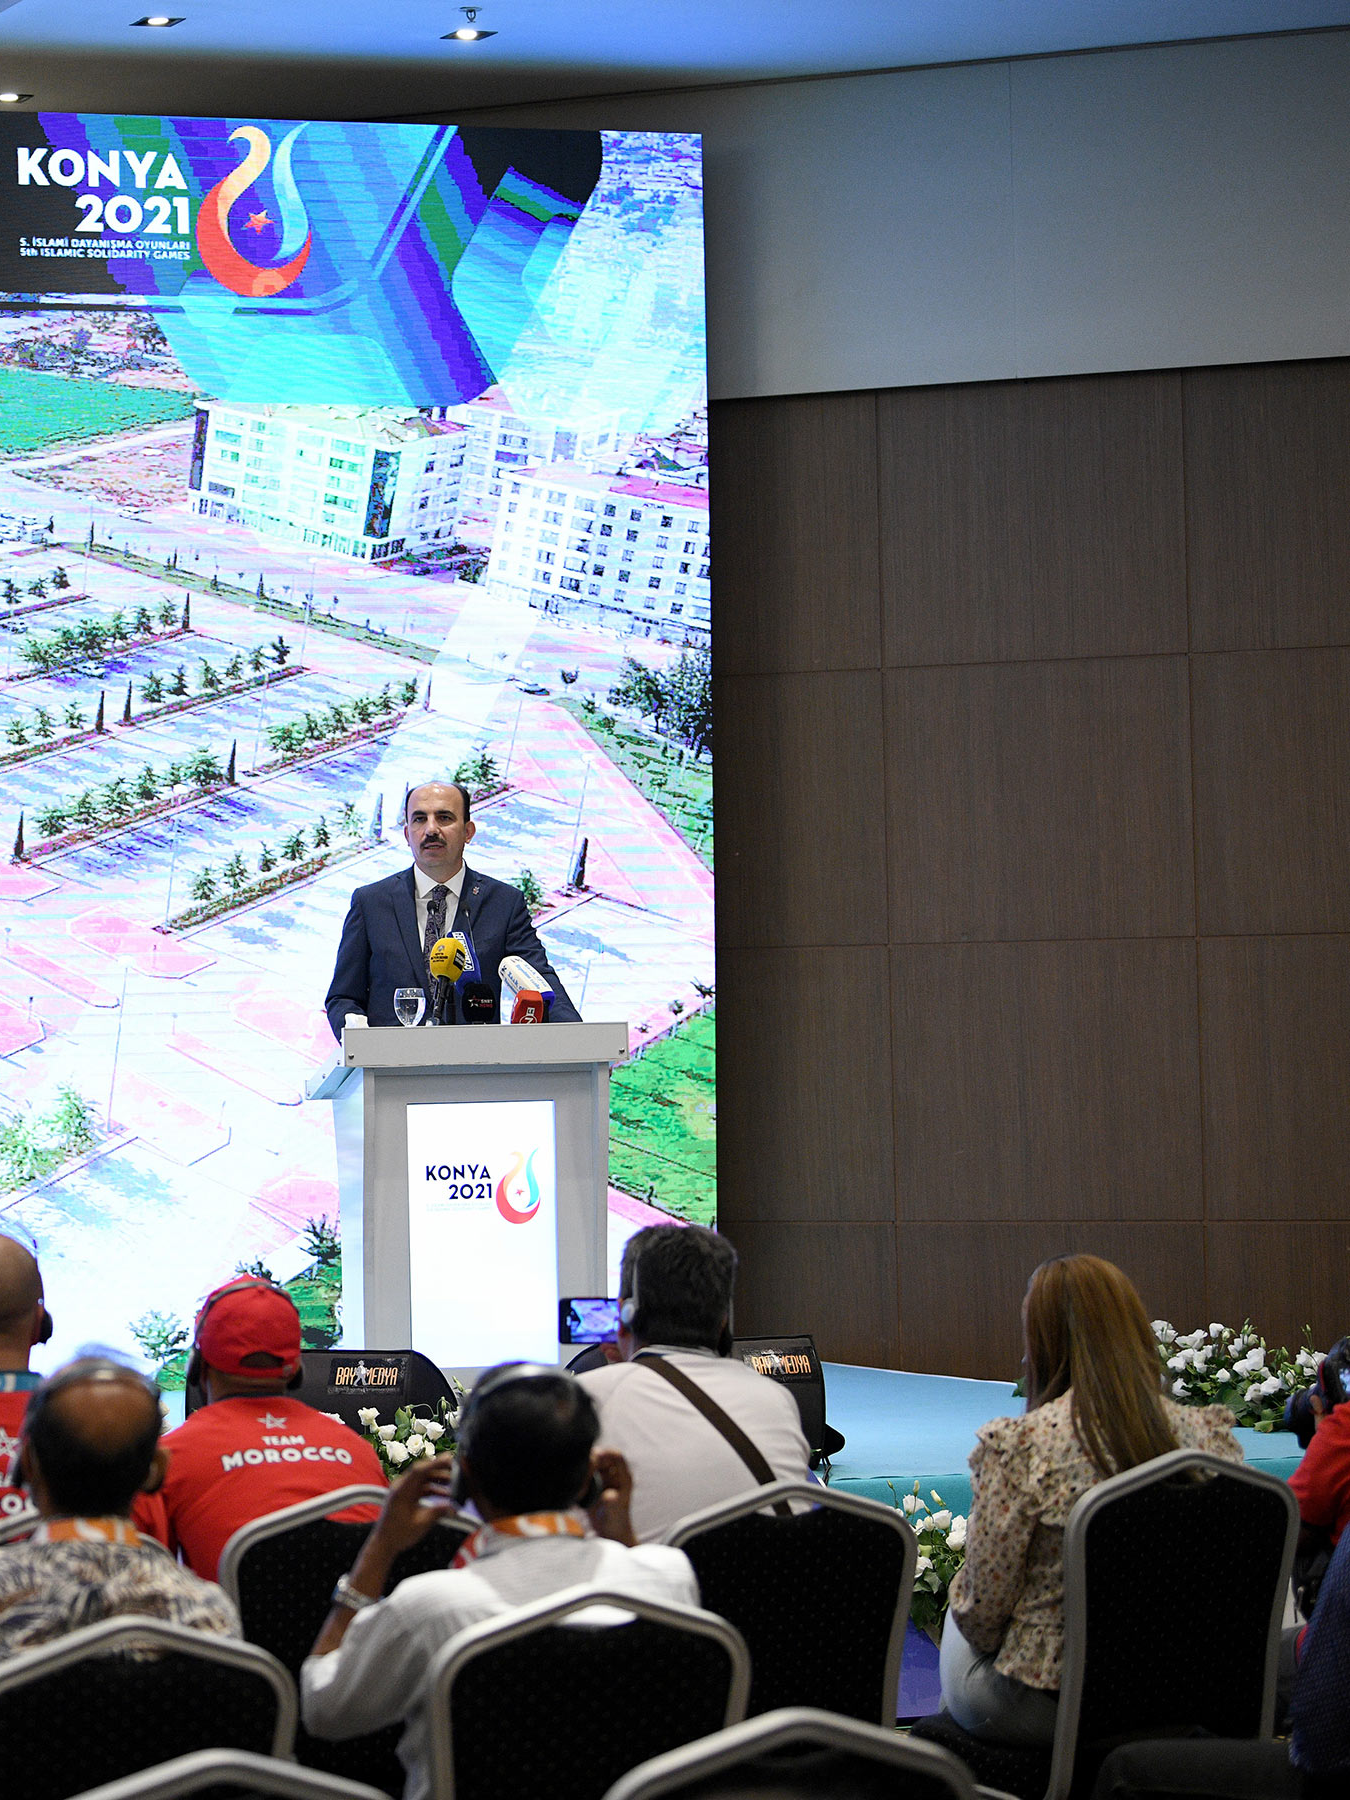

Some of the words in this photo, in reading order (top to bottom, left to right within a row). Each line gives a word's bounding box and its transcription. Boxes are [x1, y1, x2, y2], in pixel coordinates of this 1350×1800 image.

[17, 147, 188, 189] KONYA
[74, 194, 190, 234] 2021
[19, 247, 38, 257] 5th
[40, 248, 85, 258] ISLAMIC
[86, 249, 151, 259] SOLIDARITY
[153, 250, 191, 260] GAMES
[134, 240, 191, 250] OYUNLARI
[426, 1164, 491, 1181] KONYA
[449, 1183, 492, 1200] 2021
[262, 1435, 306, 1446] TEAM
[221, 1446, 353, 1472] MOROCCO
